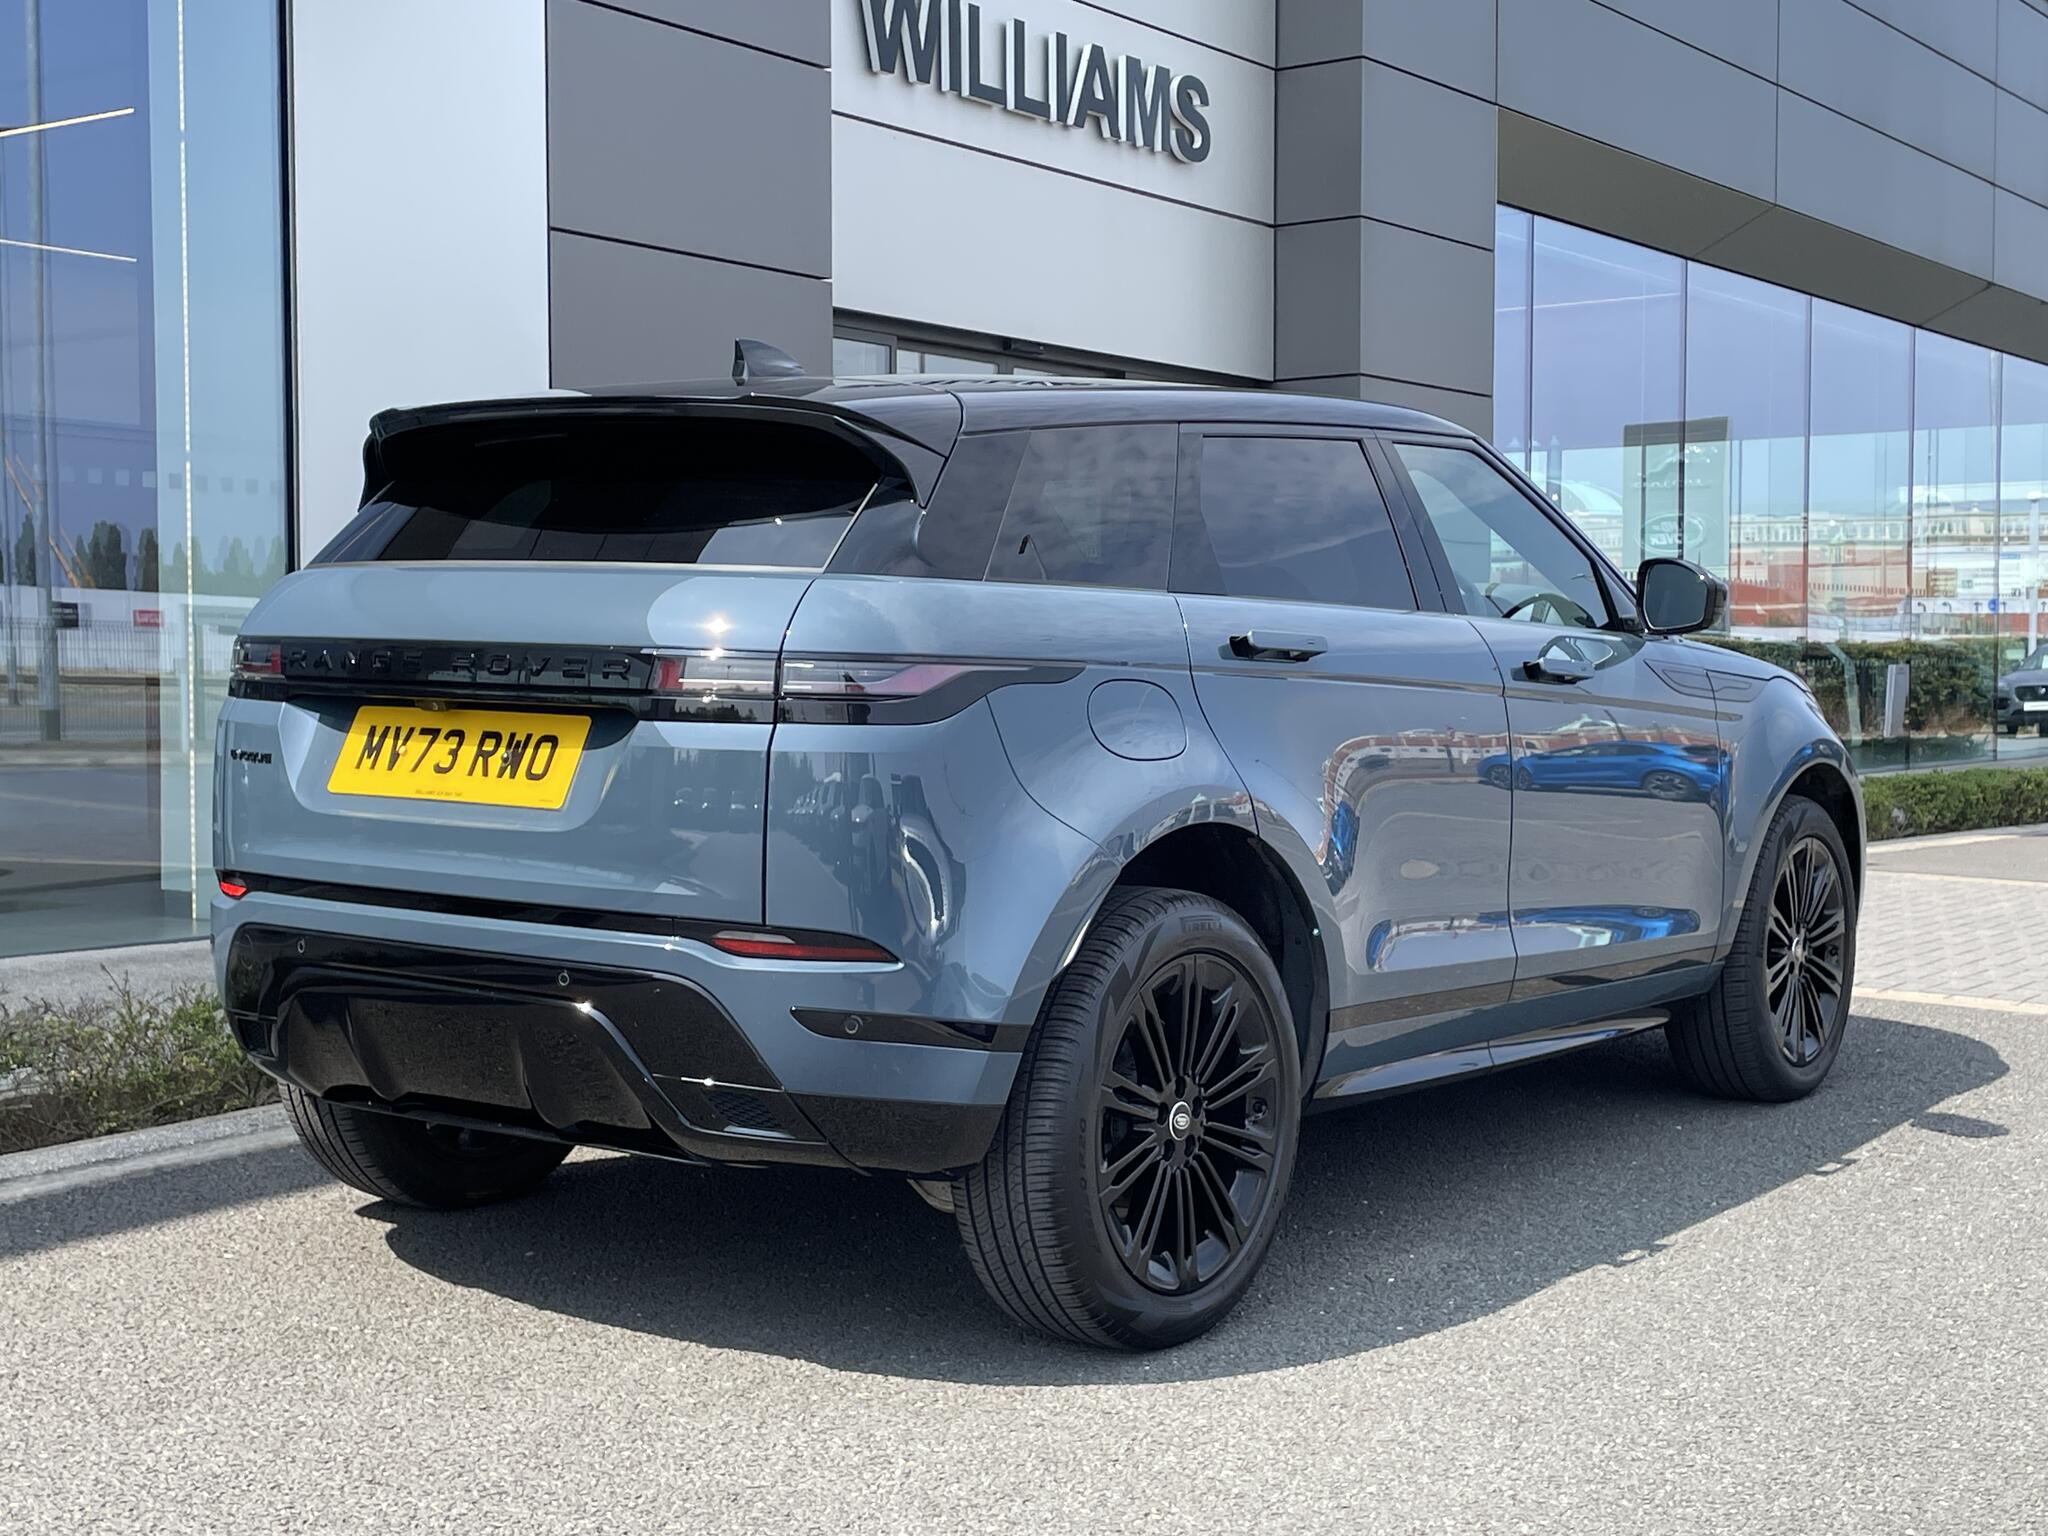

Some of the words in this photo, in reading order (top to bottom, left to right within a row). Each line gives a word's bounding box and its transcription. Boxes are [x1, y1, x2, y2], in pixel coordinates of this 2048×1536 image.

[860, 0, 1211, 164] WILLIAMS
[287, 648, 424, 673] RANGE
[452, 653, 631, 681] ROVER
[355, 725, 466, 775] MV73
[467, 730, 560, 781] RWO
